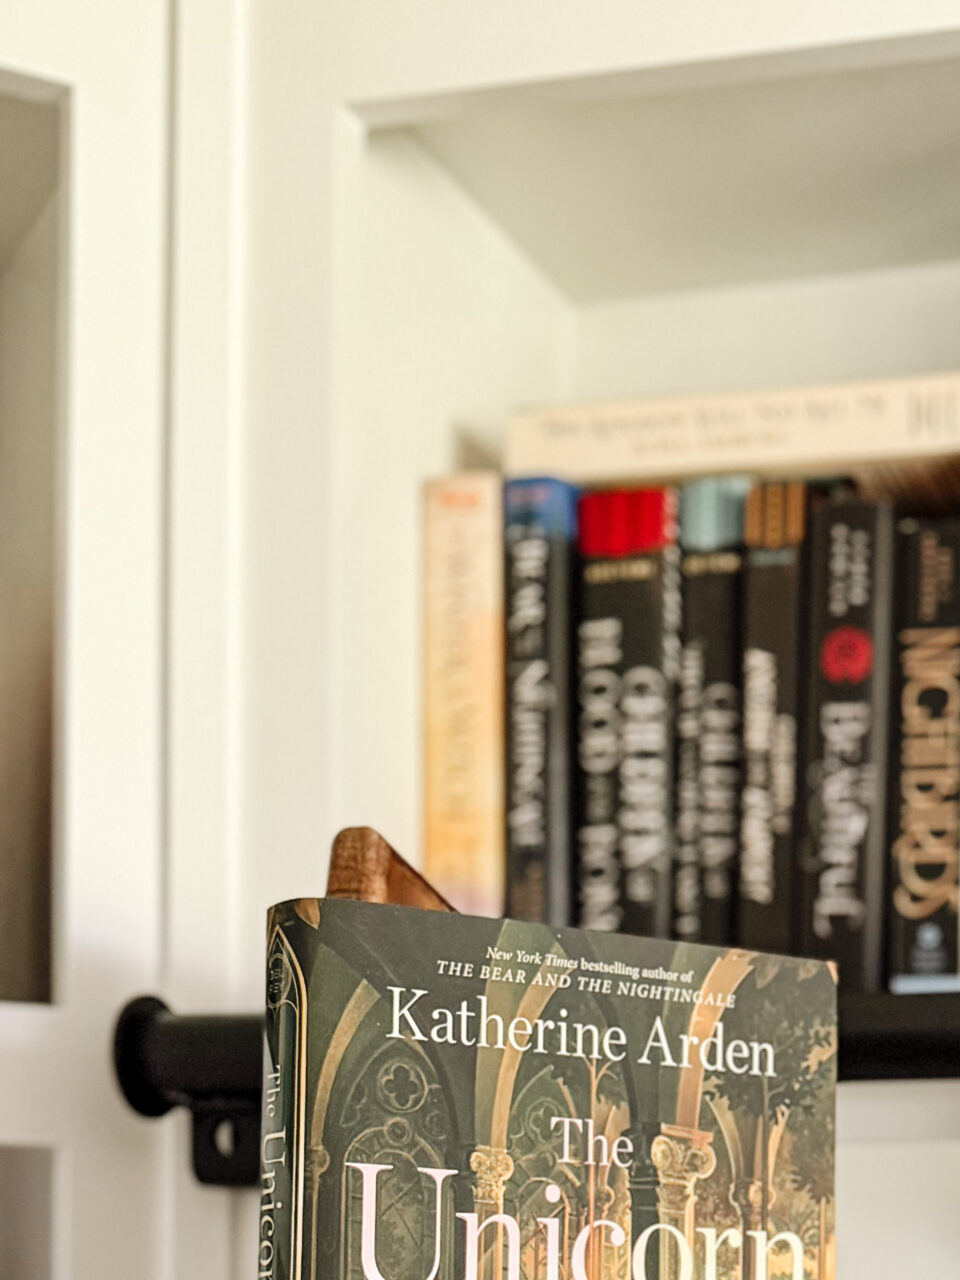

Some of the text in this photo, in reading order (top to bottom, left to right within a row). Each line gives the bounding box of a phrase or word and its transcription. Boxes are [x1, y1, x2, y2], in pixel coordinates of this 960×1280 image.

[436, 959, 737, 1009] THE BEAR AND THE NIGHTINGALE
[485, 945, 695, 984] New York Times bestselling author of
[385, 986, 778, 1078] Katherine Arden
[265, 1064, 282, 1118] The
[549, 1115, 634, 1170] The
